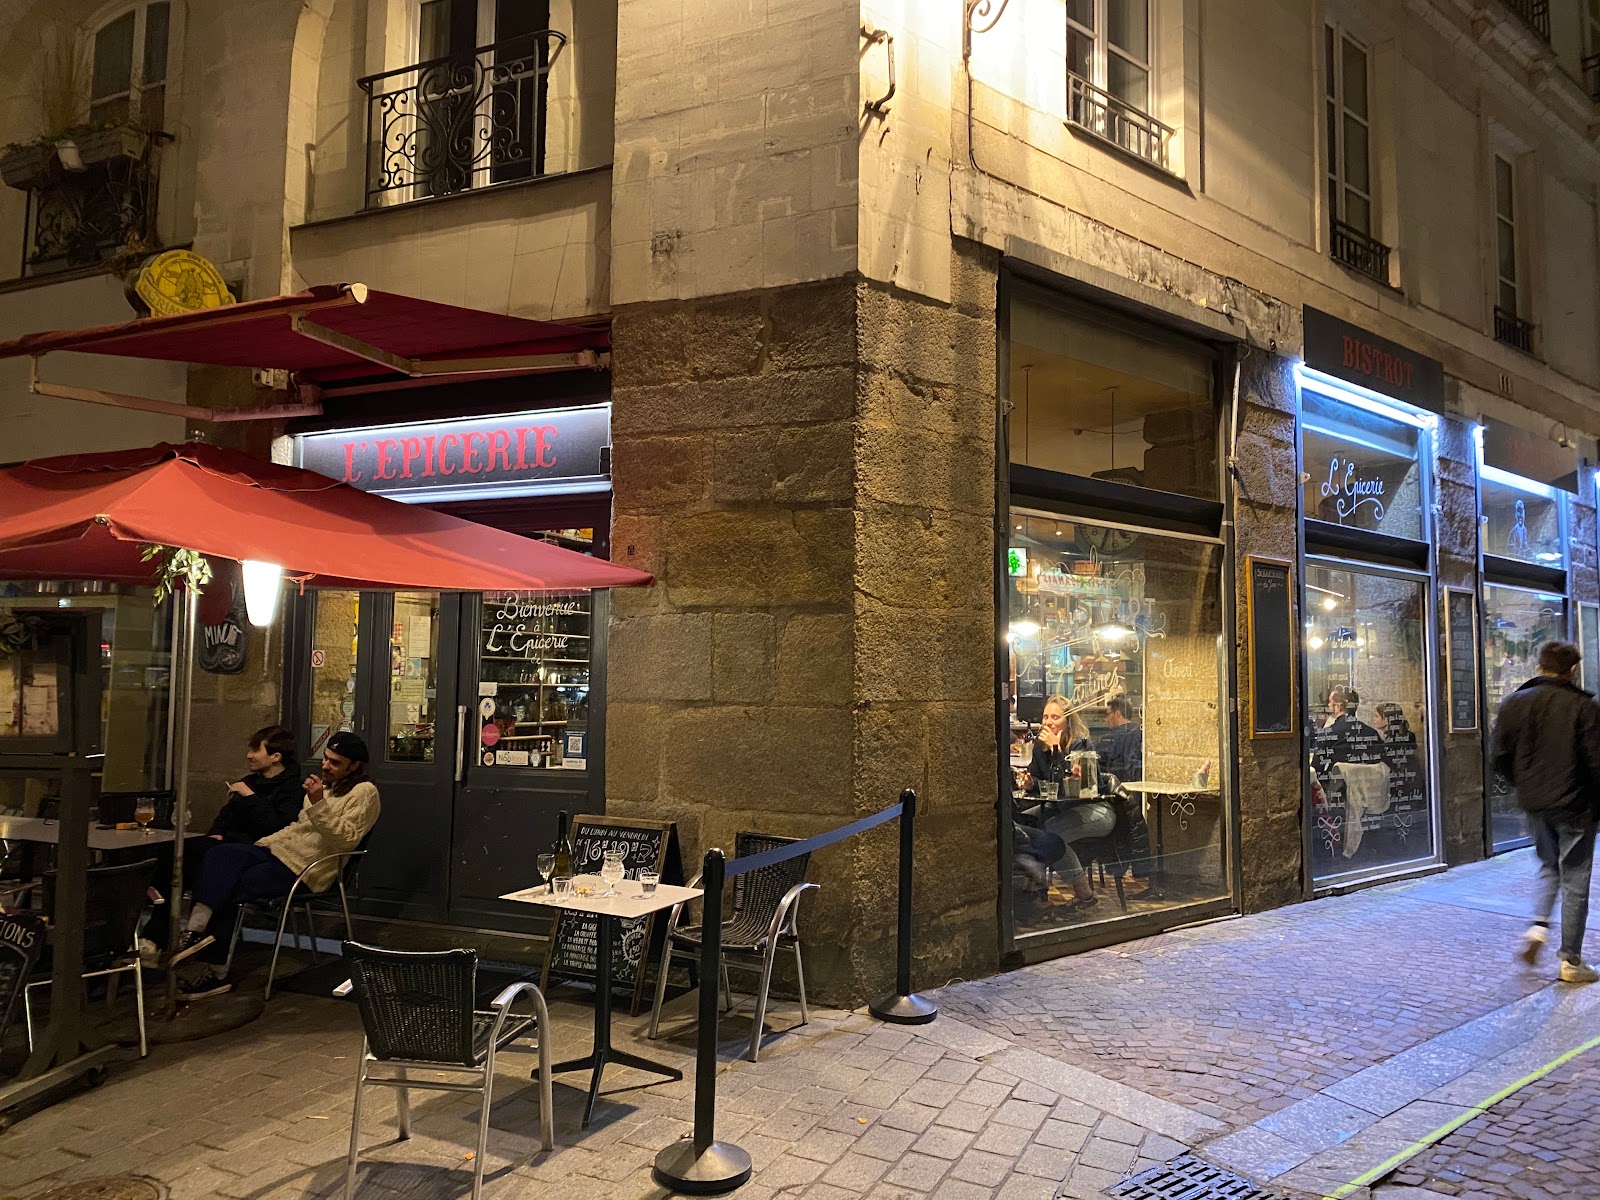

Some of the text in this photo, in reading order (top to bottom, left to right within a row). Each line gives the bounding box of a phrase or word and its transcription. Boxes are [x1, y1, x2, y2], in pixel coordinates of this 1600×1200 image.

[1342, 335, 1414, 390] BISTROT
[342, 424, 558, 483] L'EPICERIE
[1321, 458, 1385, 514] L'Epicerie
[496, 590, 575, 620] Bienvenue
[486, 623, 569, 659] L'Epicerie
[581, 826, 650, 841] DU LUNDI AU VENDREDI
[0, 919, 36, 948] IONS
